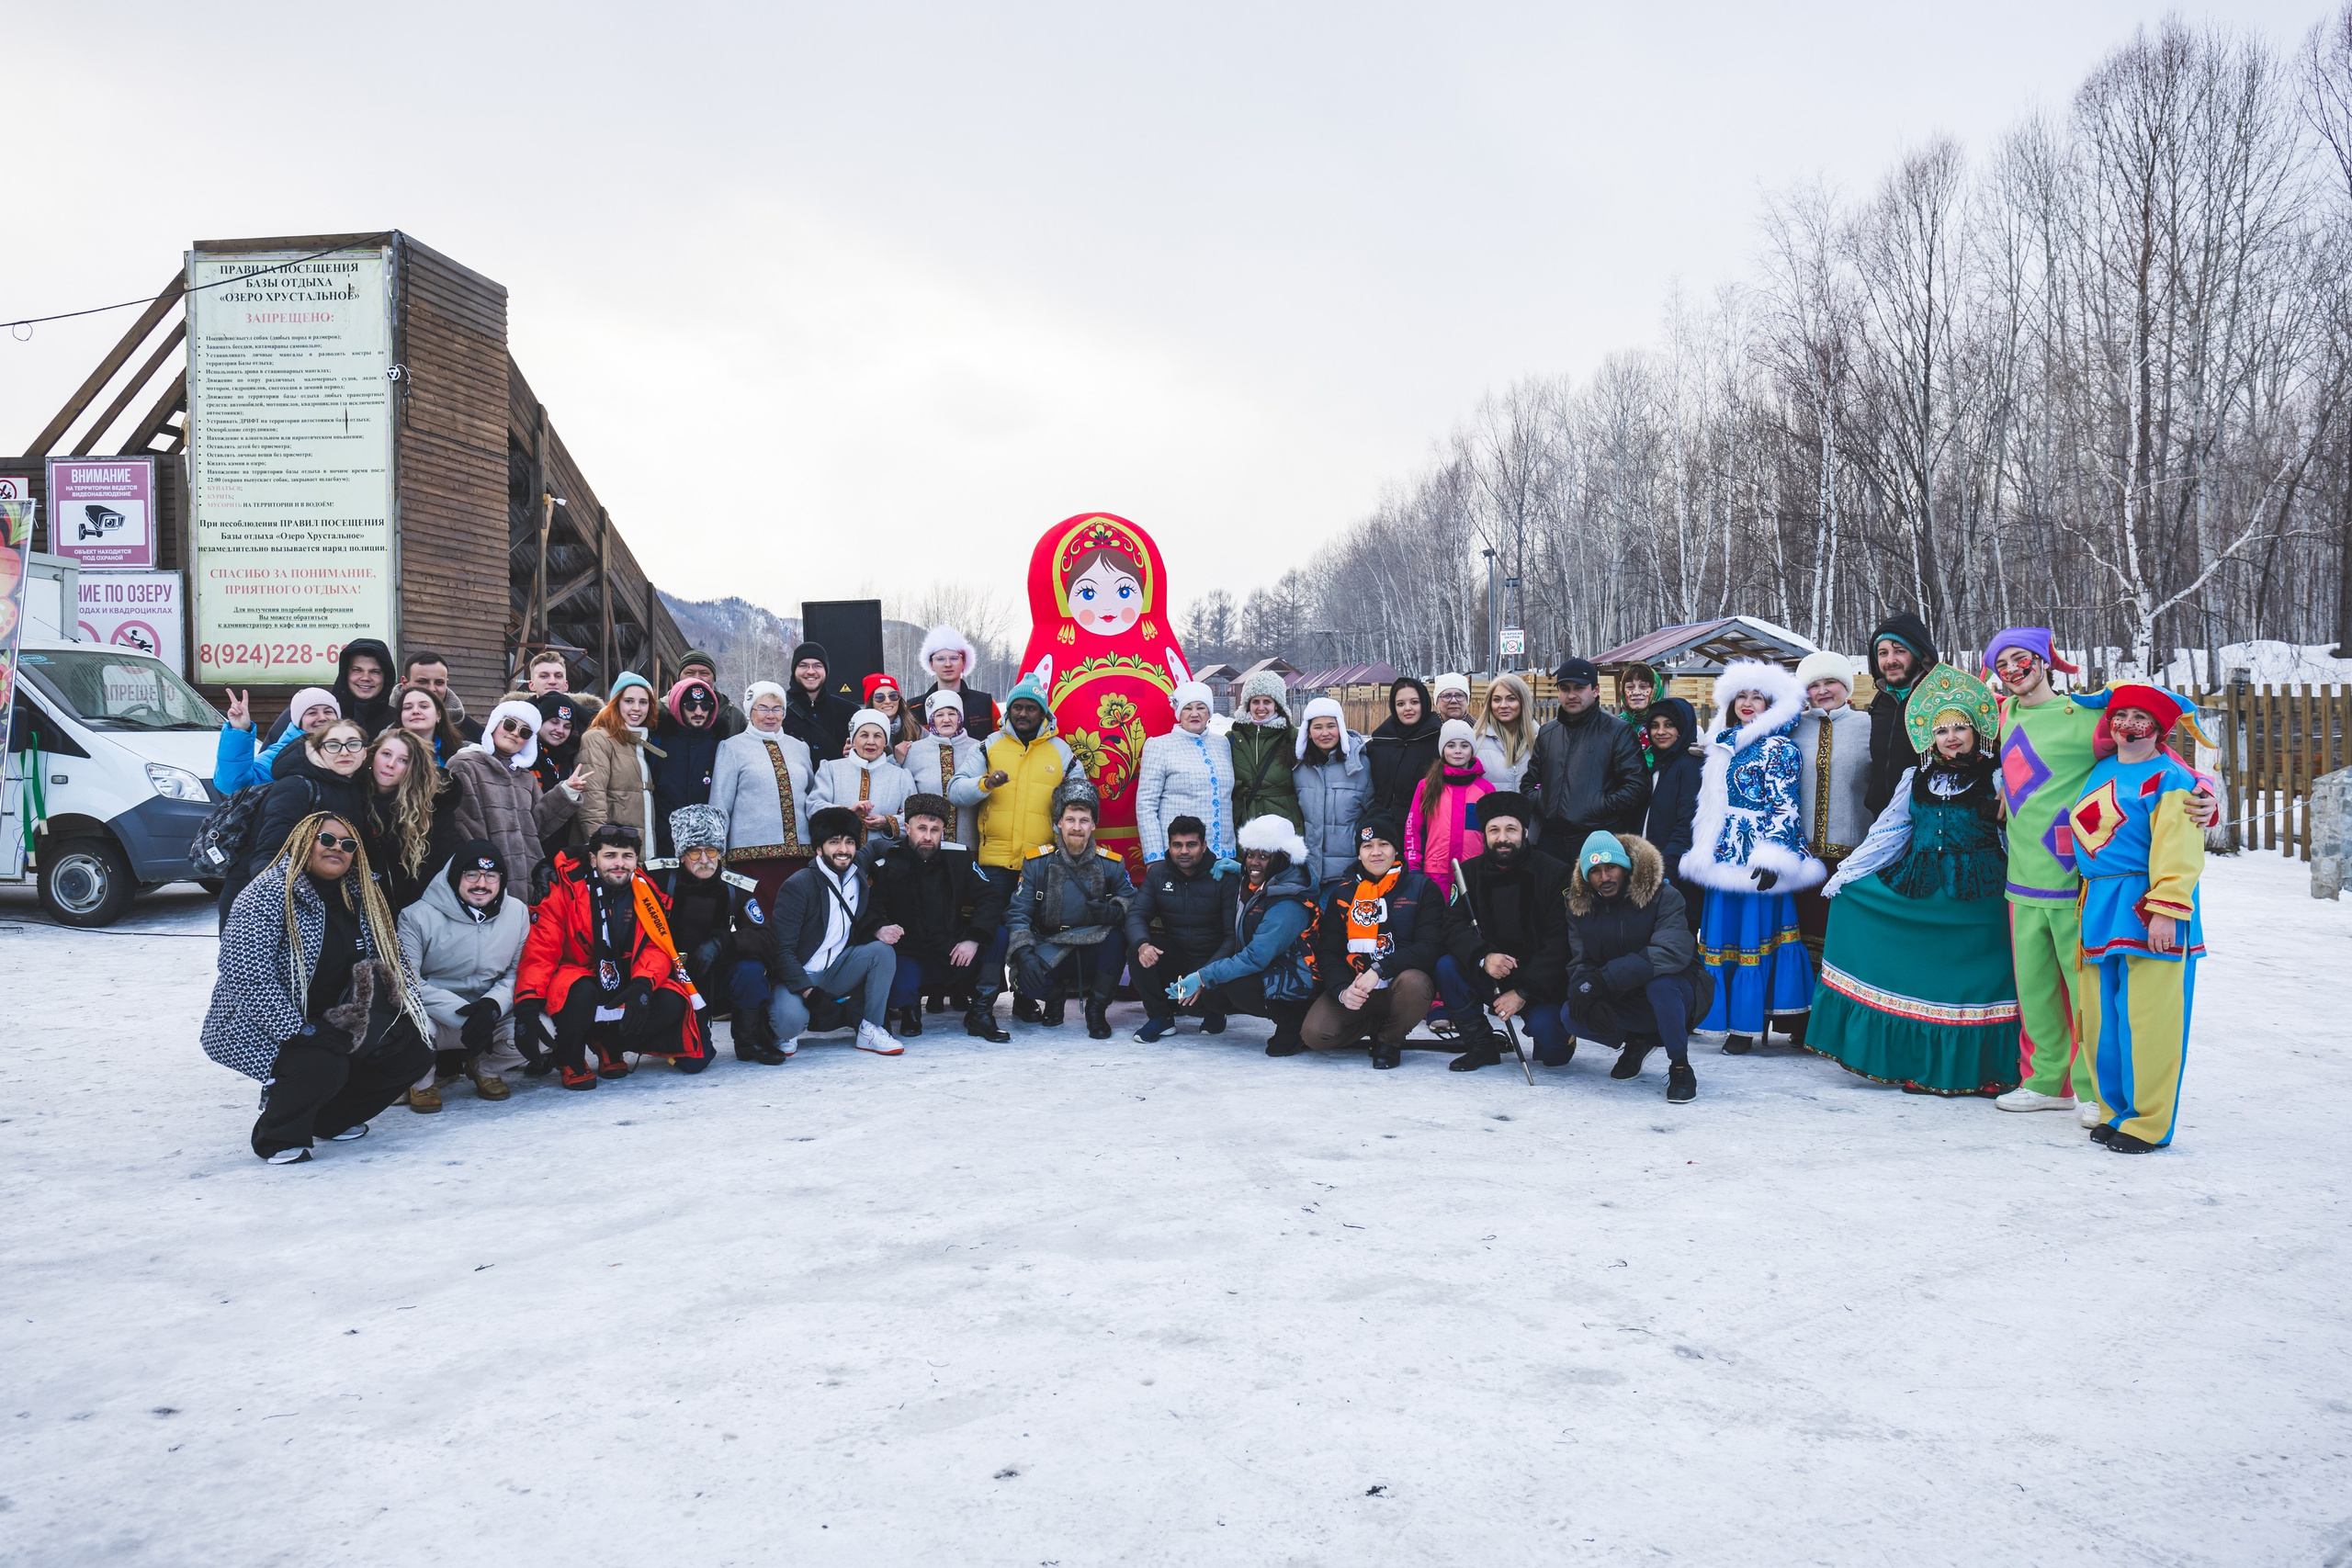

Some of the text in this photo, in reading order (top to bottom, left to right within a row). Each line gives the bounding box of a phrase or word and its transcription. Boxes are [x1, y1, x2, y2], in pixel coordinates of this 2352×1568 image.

[220, 263, 358, 275] ПРАВИЛА ПОСЕЩЕНИЯ
[246, 278, 333, 288] БАЗЫ ОТДЫХА
[220, 291, 360, 302] «ОЗЕРО ХРУСТАЛЬНОЕ»
[246, 312, 334, 324] ЗАПРЕЩЕНО:
[72, 468, 131, 483] ВНИМАНИЕ
[199, 519, 384, 529] При несоблюдения ПРАВИЛ ПОСЕЩЕНИЯ
[276, 532, 304, 541] «Озеро
[307, 532, 364, 541] Хрустальное»
[198, 545, 268, 553] незамедлительно
[322, 545, 346, 554] наряд
[210, 569, 377, 580] СПАСИБО ЗА ПОНИМАНИЕ,
[105, 584, 123, 603] ПО
[128, 584, 172, 603] ОЗЕРУ
[225, 584, 361, 595] ПРИЯТНОГО ОТДЫХА!
[200, 643, 348, 669] 8(924)228-6
[105, 684, 175, 703] ПРЕЩЕО
